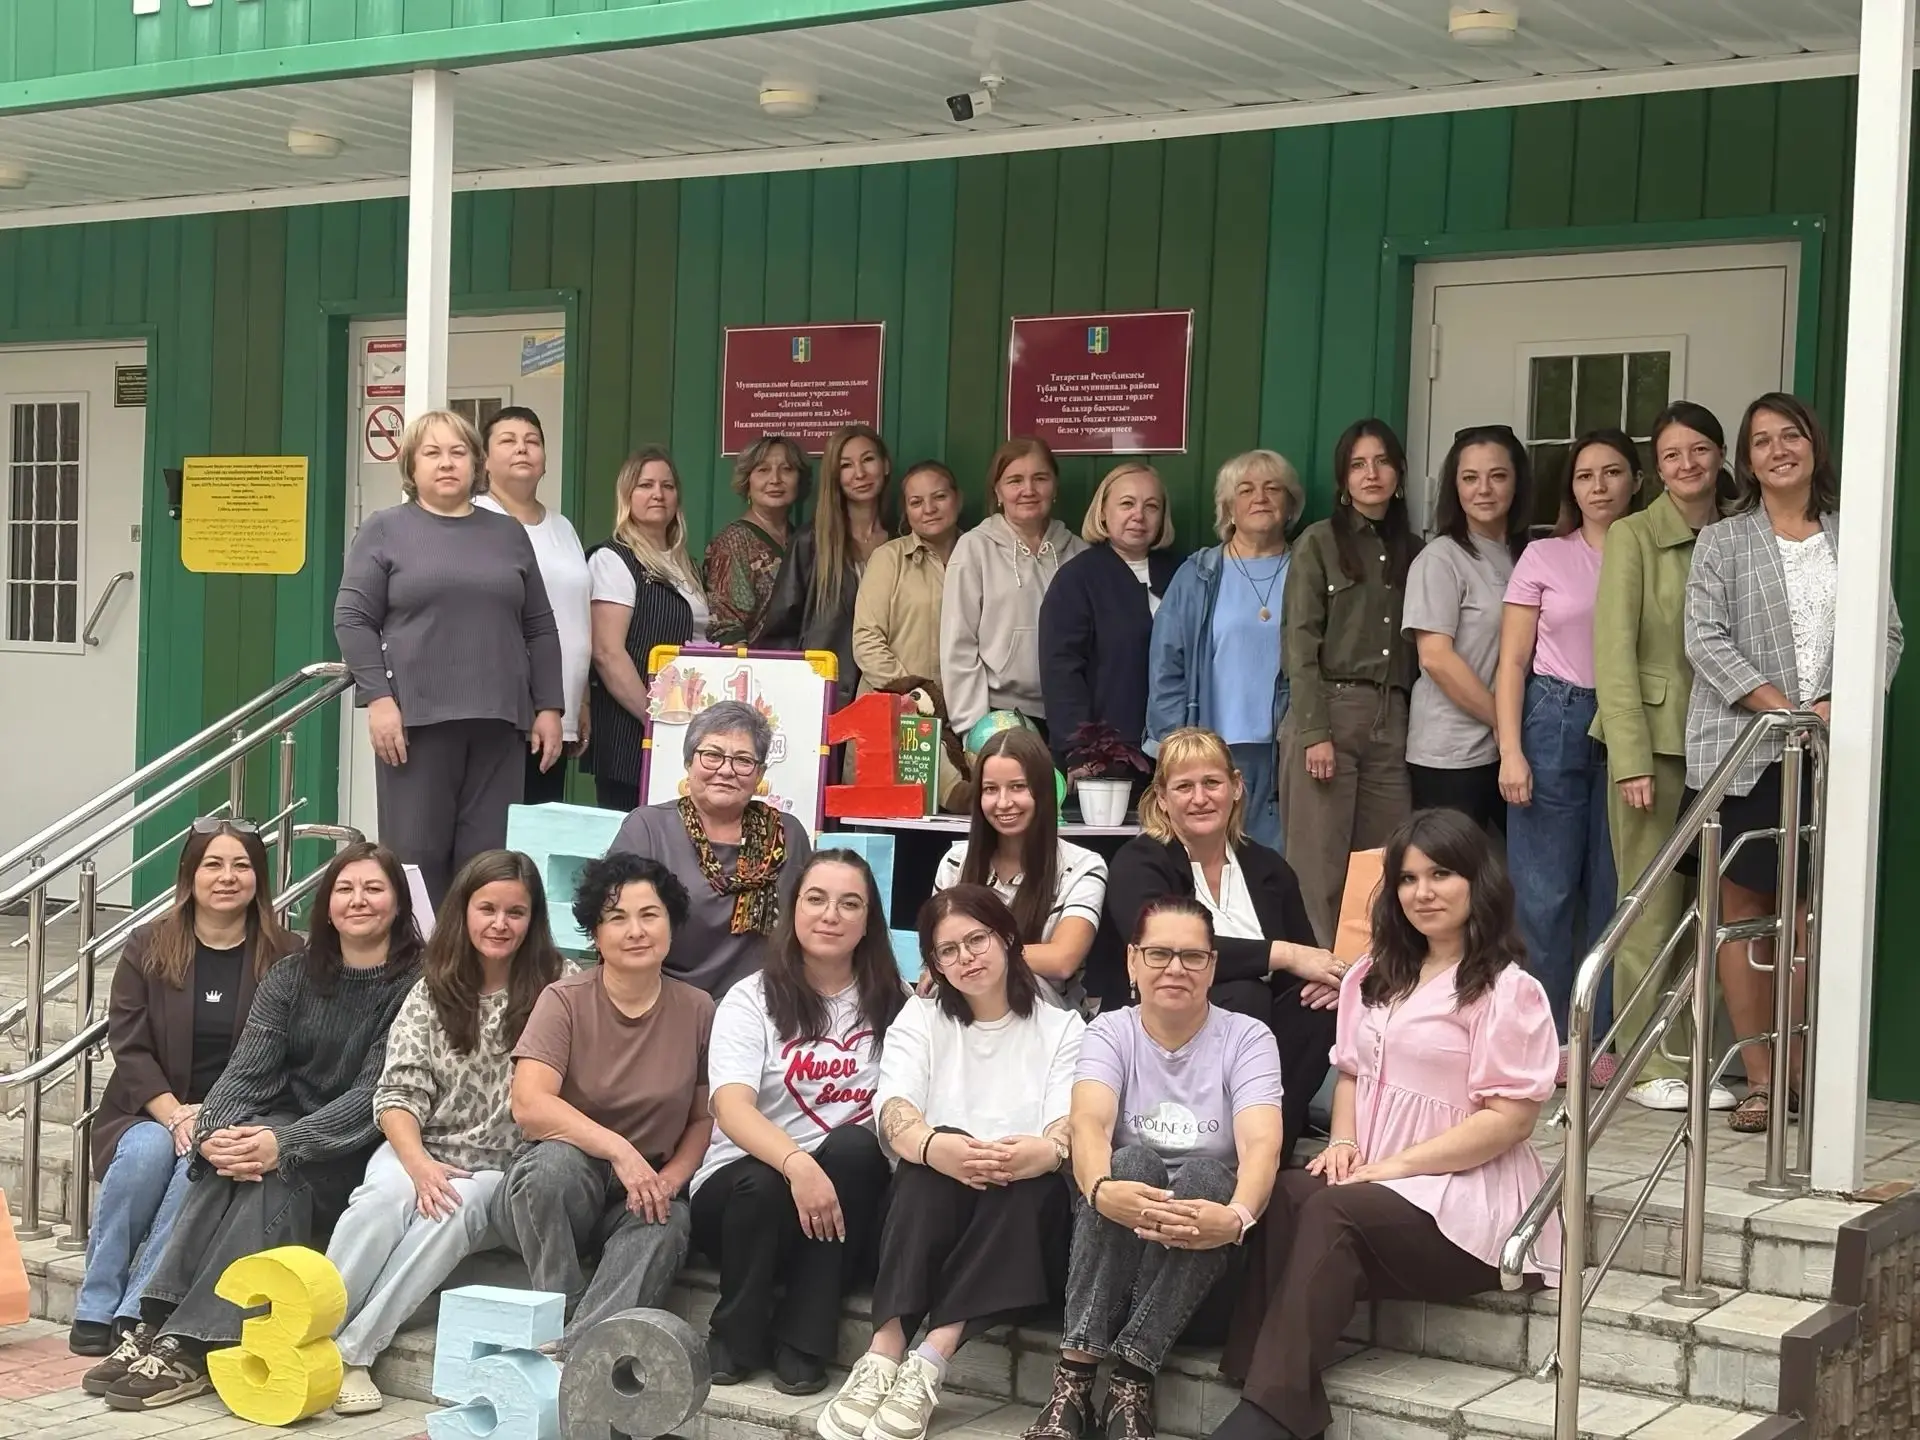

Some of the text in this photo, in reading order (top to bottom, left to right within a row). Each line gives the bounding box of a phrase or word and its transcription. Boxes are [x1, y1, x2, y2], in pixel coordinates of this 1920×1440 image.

[1050, 372, 1145, 383] Татарстан Республикасы
[736, 381, 788, 390] Муниципальное
[1060, 384, 1079, 392] Кама
[1080, 384, 1128, 393] муниципаль
[1129, 382, 1160, 392] районы
[1036, 416, 1082, 426] муниципаль
[1057, 426, 1079, 434] белем
[825, 692, 928, 818] 1
[1122, 1110, 1220, 1134] CAROLINE & CO
[206, 1244, 348, 1427] 3
[425, 1284, 566, 1440] 5
